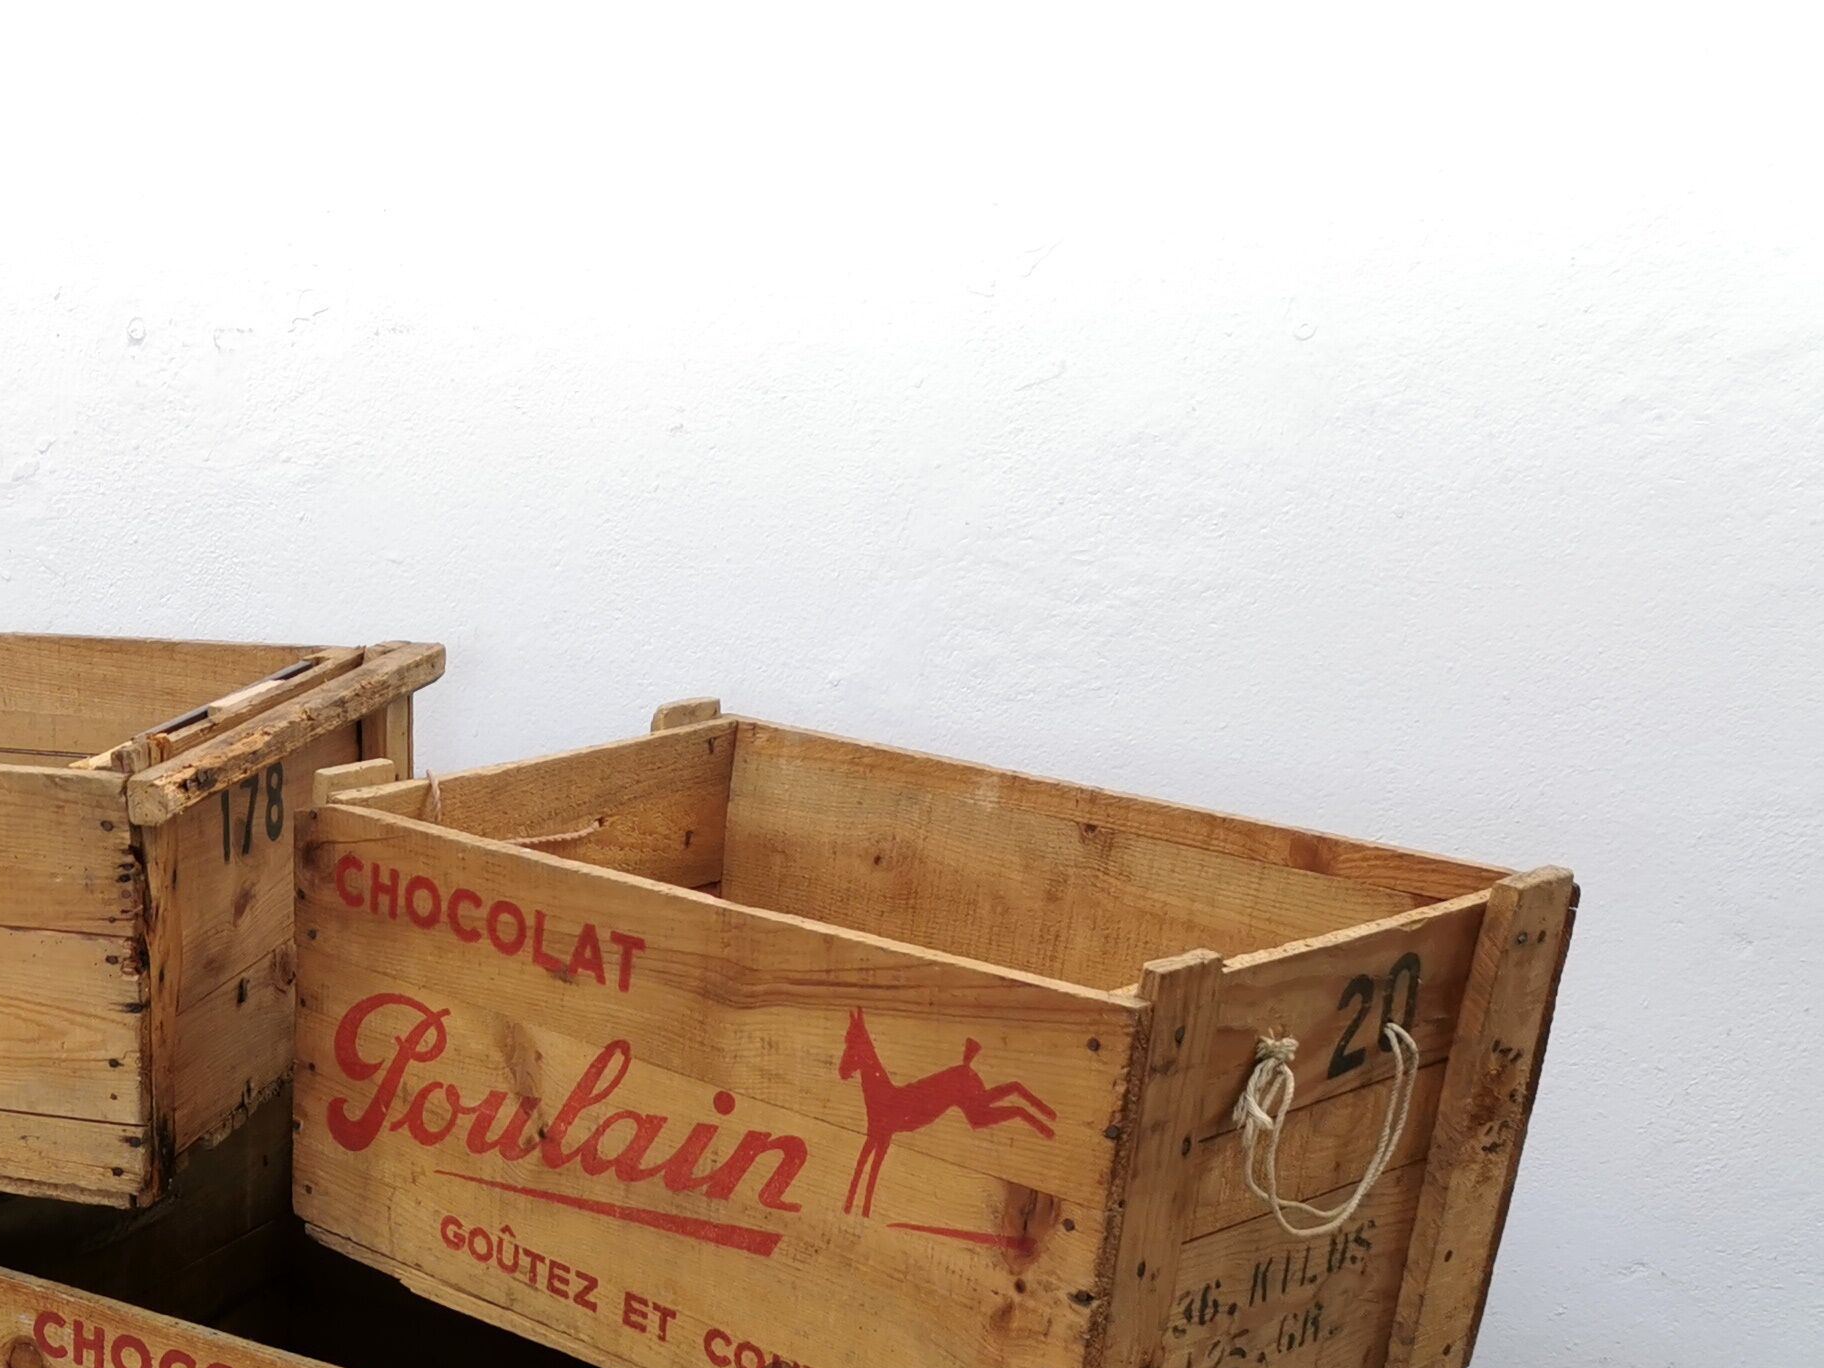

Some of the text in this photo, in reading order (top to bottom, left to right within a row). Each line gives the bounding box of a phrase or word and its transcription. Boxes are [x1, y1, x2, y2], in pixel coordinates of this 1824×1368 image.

[335, 854, 646, 992] CHOCOLAT
[1327, 952, 1421, 1080] 20
[327, 993, 809, 1213] Poulain
[439, 1214, 598, 1312] GOÛTEZ
[622, 1292, 676, 1342] ET
